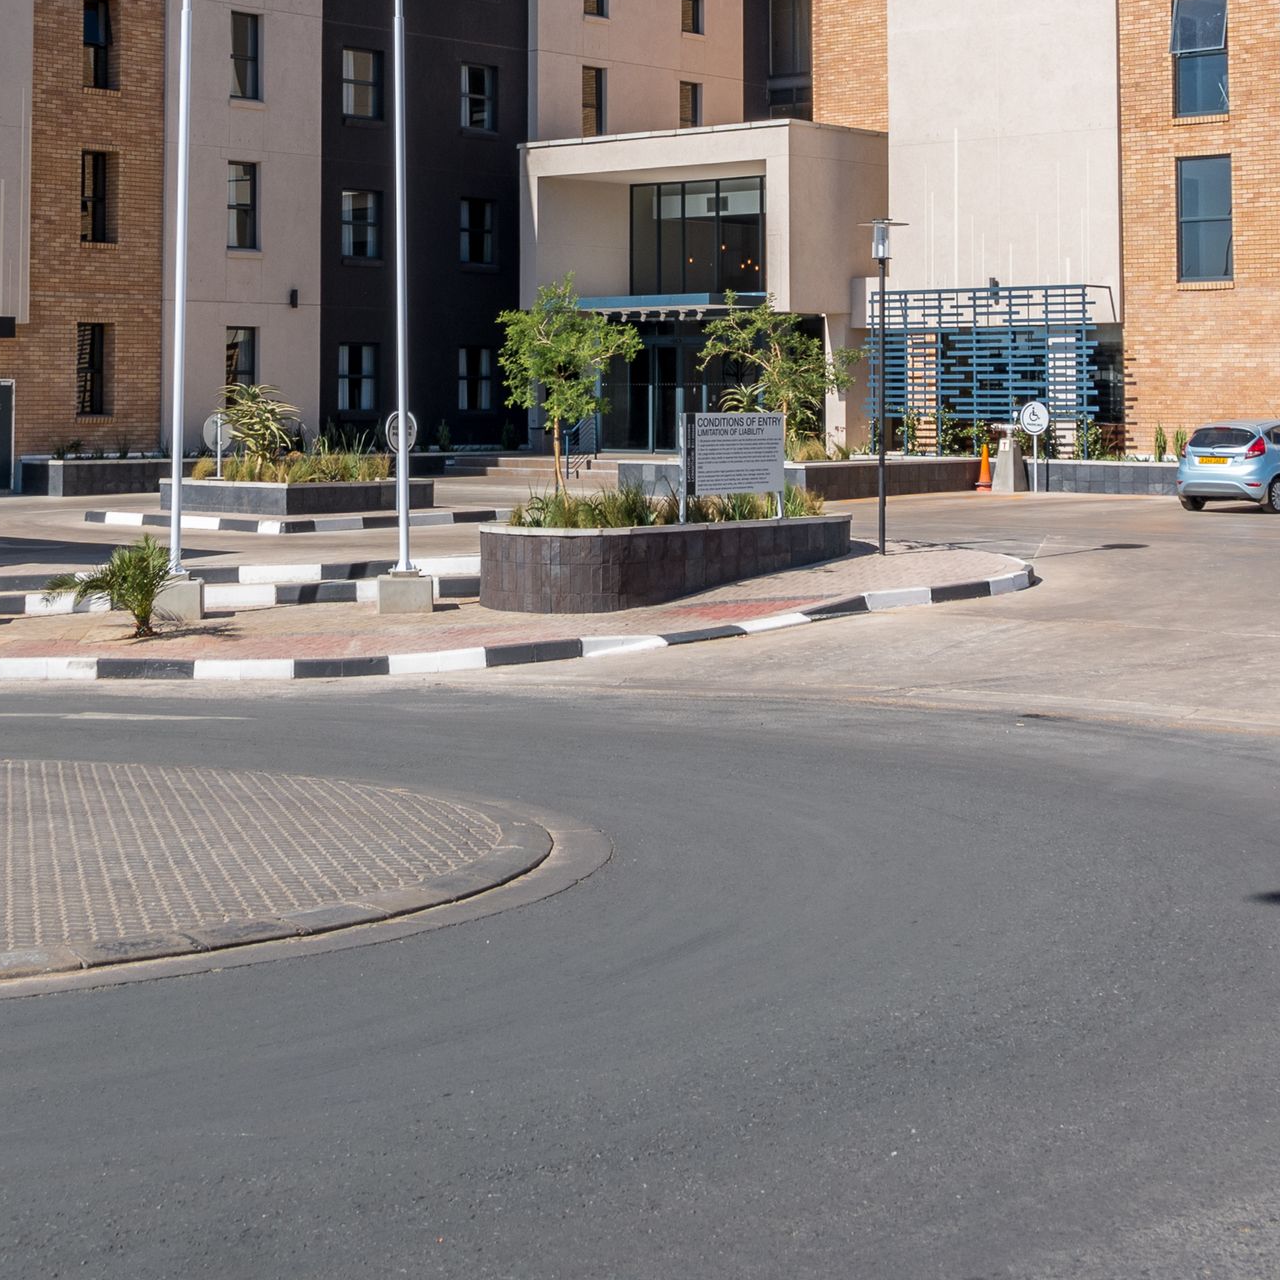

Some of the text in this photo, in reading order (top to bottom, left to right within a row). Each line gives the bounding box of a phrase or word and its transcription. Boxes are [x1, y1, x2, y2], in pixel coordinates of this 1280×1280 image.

[697, 416, 782, 427] CONDITIONS OF ENTRY
[697, 427, 764, 437] LIMITATION OF LIABILITY
